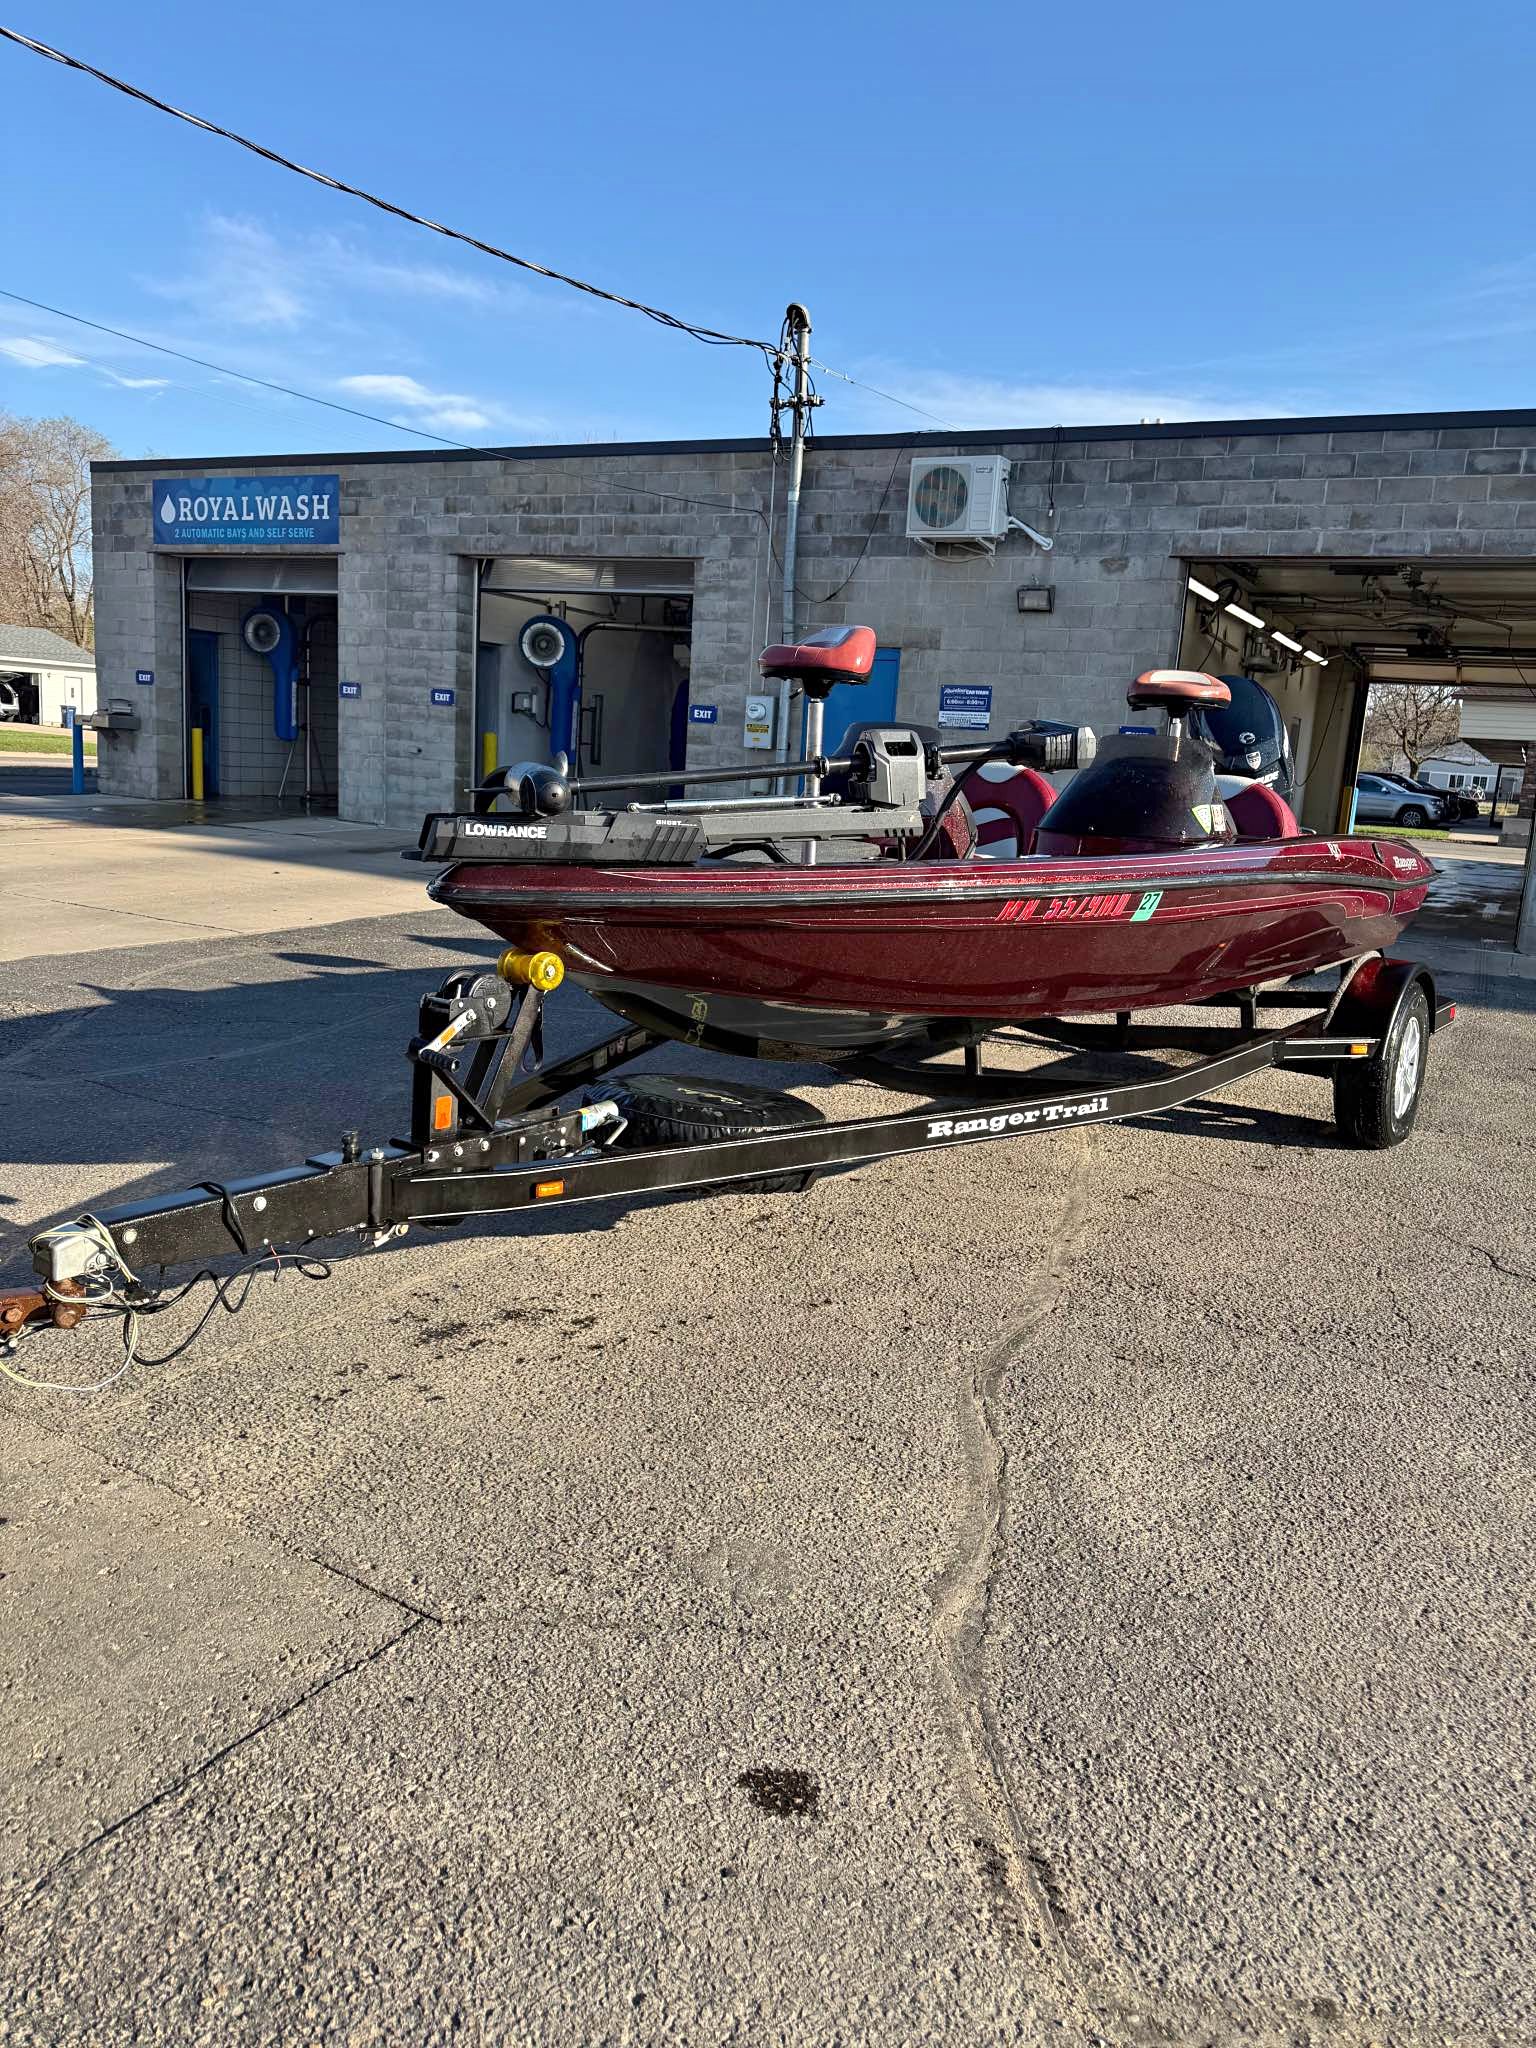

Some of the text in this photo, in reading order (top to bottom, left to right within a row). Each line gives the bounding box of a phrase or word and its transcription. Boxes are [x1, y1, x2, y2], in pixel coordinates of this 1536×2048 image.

[178, 494, 330, 522] ROYALWASH
[174, 527, 316, 539] 2 AUTOMATIC BAYS AND SELF SERVE
[138, 673, 151, 683] EXIT
[342, 686, 357, 695] EXIT
[434, 692, 451, 702] EXIT
[693, 708, 713, 720] EXIT
[464, 823, 548, 840] LOWRANCE
[1392, 855, 1418, 871] Ranger
[1140, 893, 1162, 911] 27
[927, 1097, 1109, 1139] Ranger Trail
